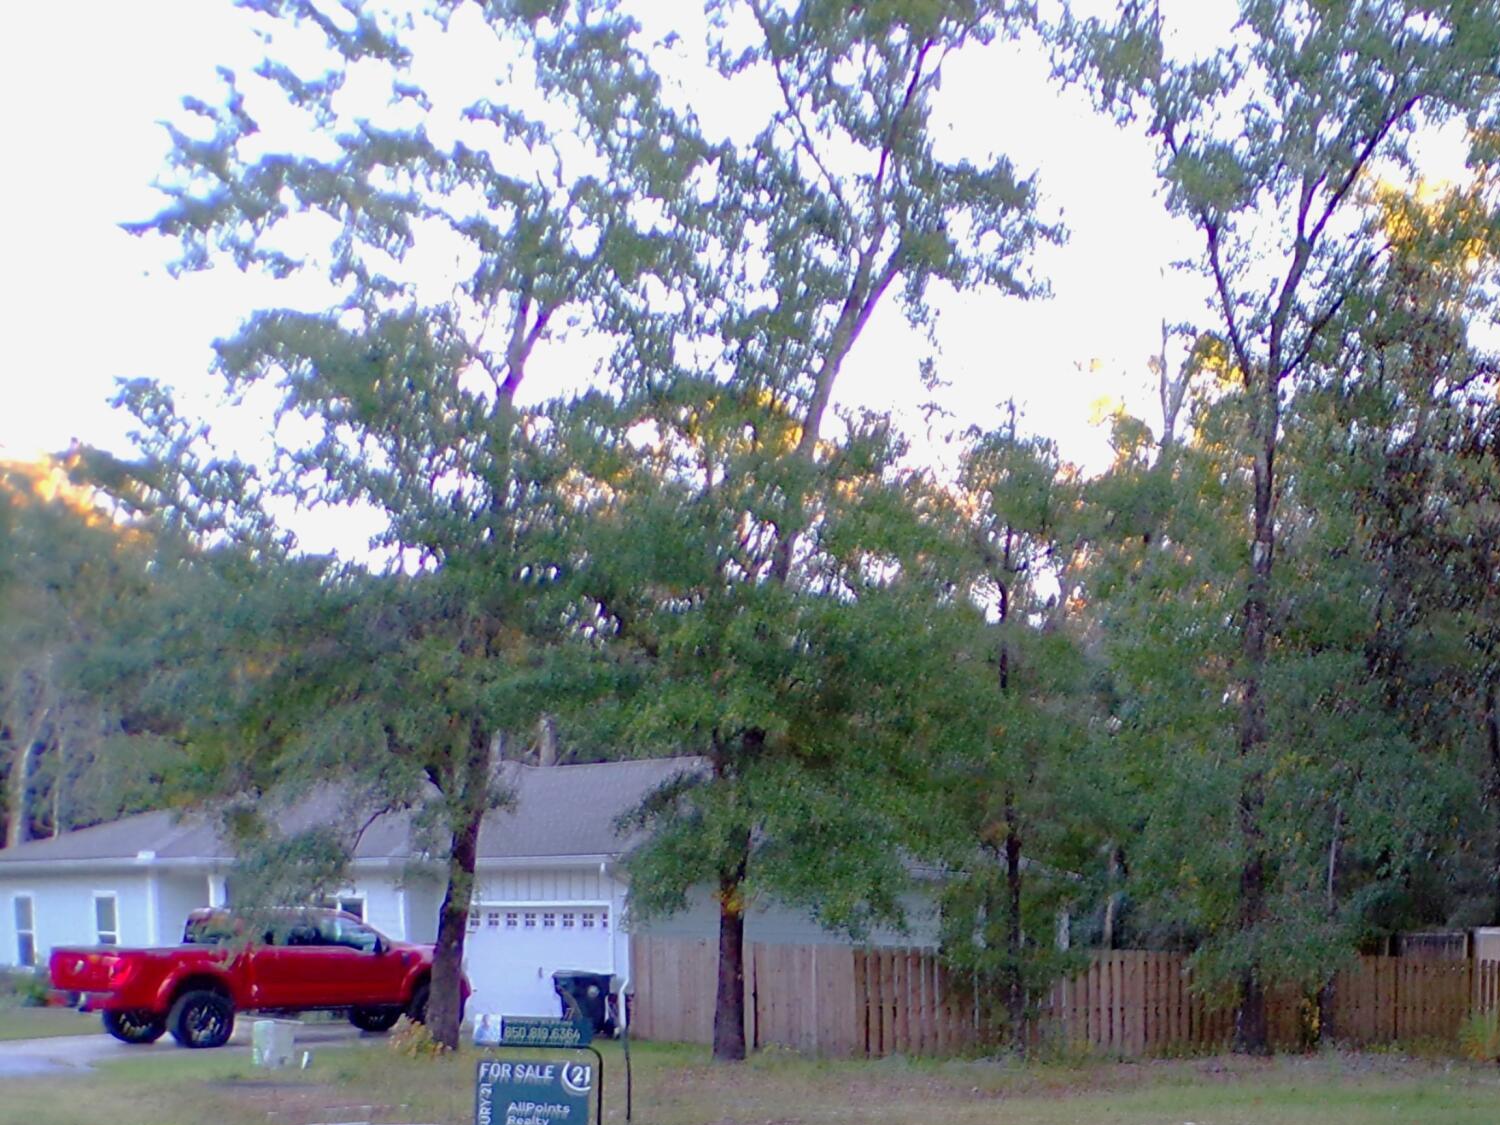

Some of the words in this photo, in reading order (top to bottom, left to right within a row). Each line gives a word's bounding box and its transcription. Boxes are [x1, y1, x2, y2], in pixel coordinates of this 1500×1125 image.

[480, 1062, 511, 1079] FOR
[515, 1063, 555, 1080] SALE
[480, 1083, 493, 1095] 21
[507, 1101, 570, 1114] AllPoints
